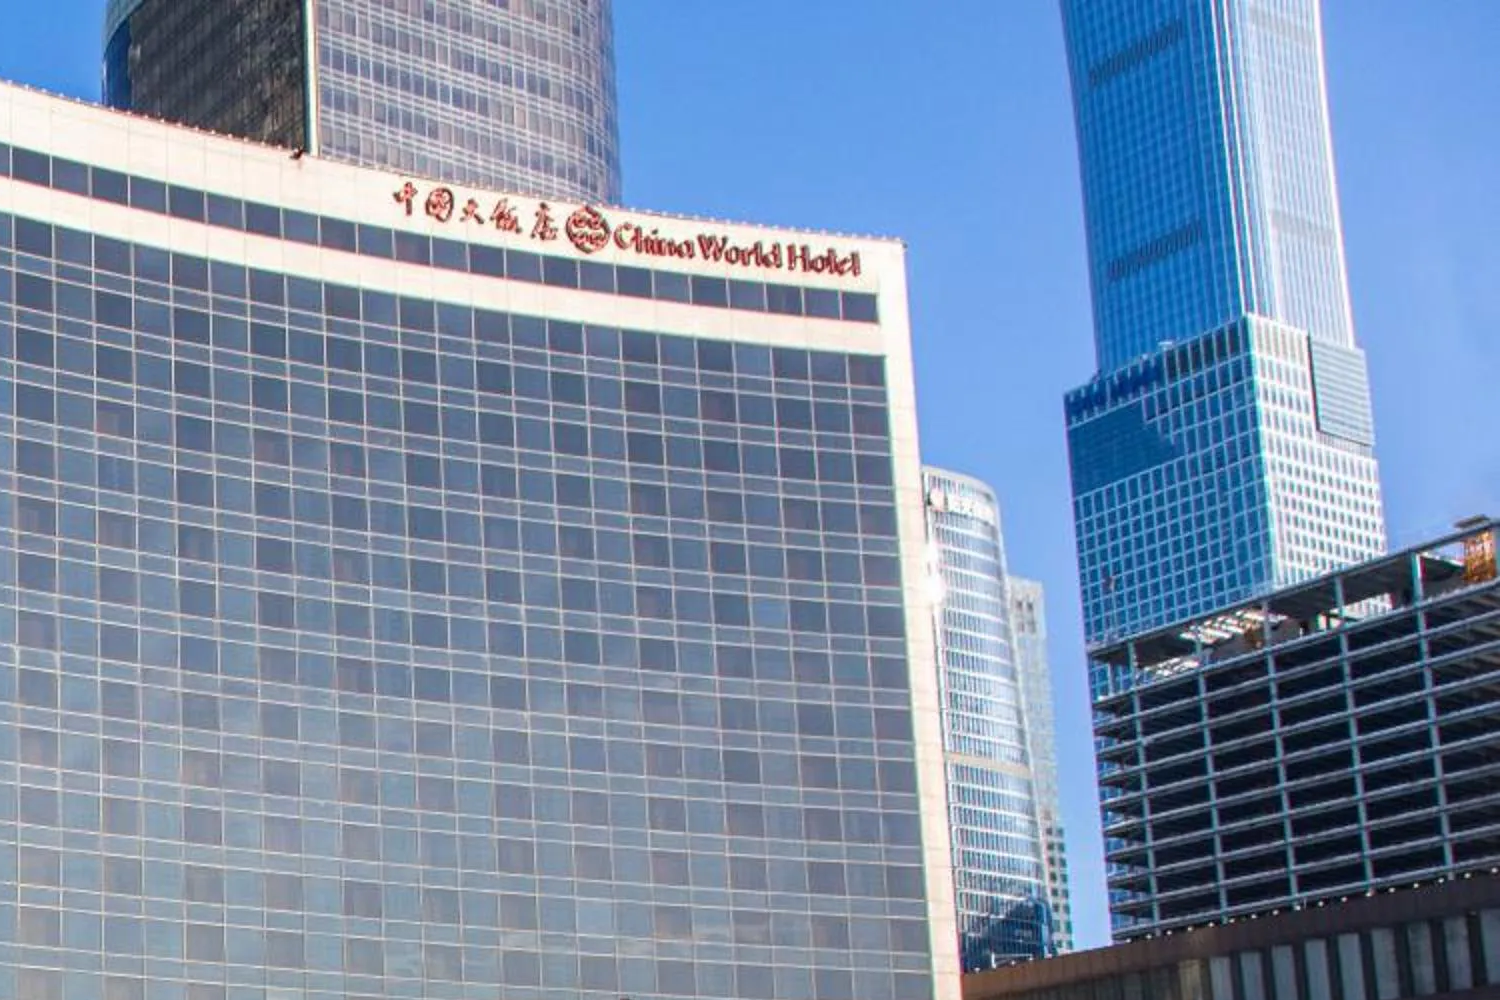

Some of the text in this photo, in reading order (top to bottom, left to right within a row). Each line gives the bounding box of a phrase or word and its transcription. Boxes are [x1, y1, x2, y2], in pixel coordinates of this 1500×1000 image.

[614, 221, 862, 277] China World Hotel
